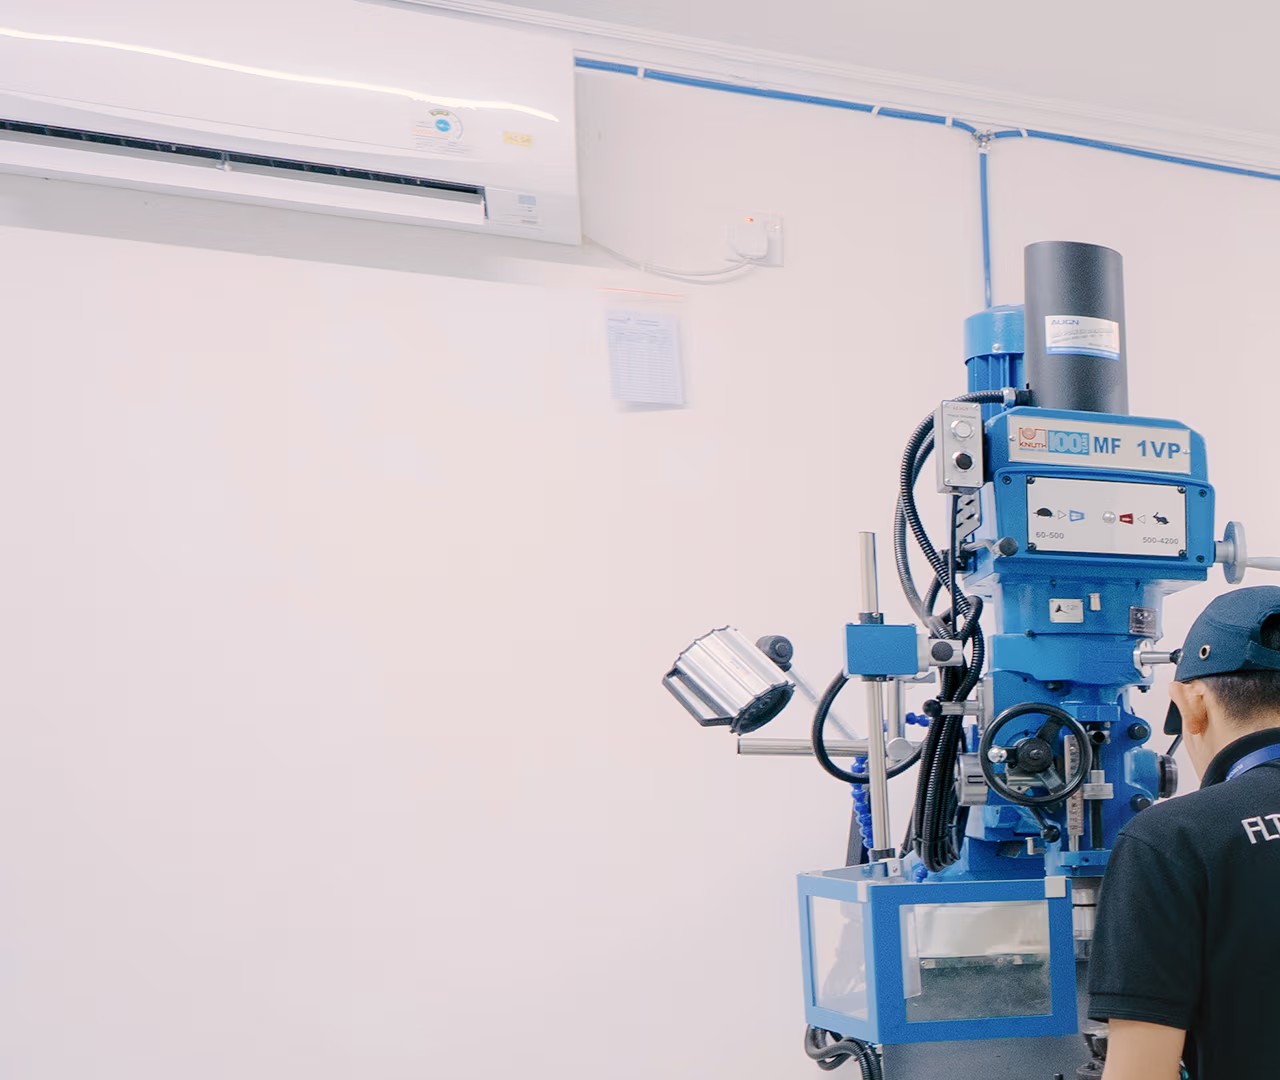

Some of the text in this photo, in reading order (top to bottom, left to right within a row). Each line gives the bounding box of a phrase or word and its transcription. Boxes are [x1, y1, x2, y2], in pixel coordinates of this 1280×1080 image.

[1093, 436, 1181, 459] MF 1VP
[1035, 531, 1065, 540] 60-500
[1142, 537, 1179, 545] 500-4200
